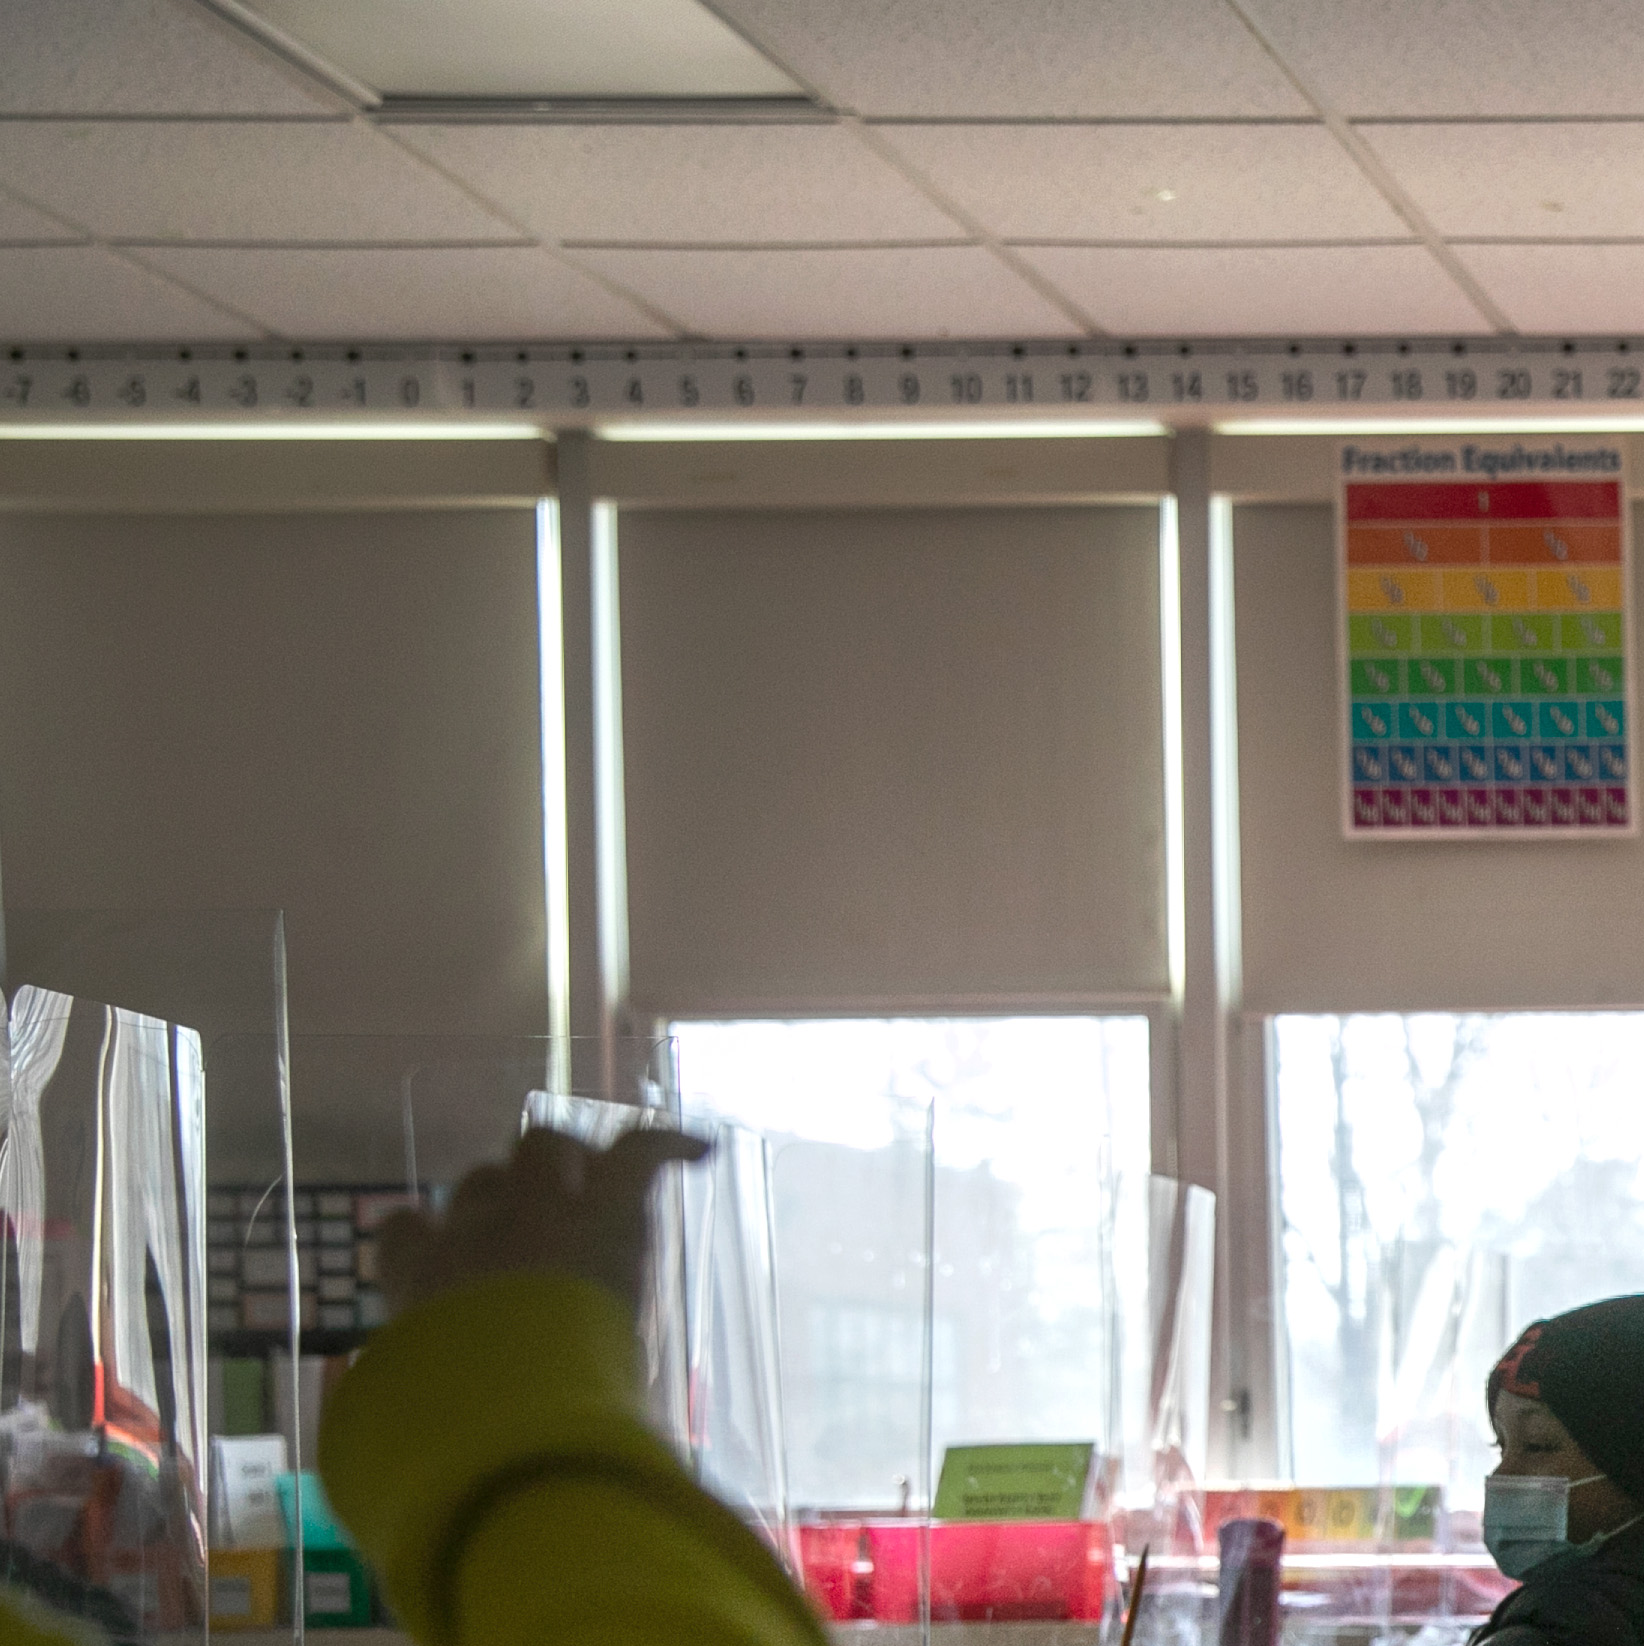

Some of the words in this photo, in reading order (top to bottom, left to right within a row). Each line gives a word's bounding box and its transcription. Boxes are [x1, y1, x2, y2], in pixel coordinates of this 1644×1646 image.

[461, 377, 477, 408] 1
[515, 377, 535, 409] 2
[569, 376, 590, 408] 3
[624, 376, 645, 408] 4
[678, 375, 700, 407] 5
[733, 376, 754, 407] 6
[788, 373, 809, 405] 7
[844, 374, 864, 406] 8
[898, 373, 920, 405] 9
[950, 373, 983, 404] 10
[1005, 373, 1034, 402] 11
[1059, 371, 1092, 403] 12
[1117, 372, 1150, 404] 13
[1172, 372, 1203, 400] 14
[1226, 370, 1258, 402] 15
[1281, 370, 1313, 401] 16
[1335, 369, 1367, 400] 17
[1390, 369, 1423, 400] 18
[1445, 369, 1477, 400] 19
[1497, 369, 1532, 399] 20
[1551, 368, 1583, 399] 21
[1607, 367, 1641, 399] 22
[1342, 446, 1455, 473] Fraction
[1461, 445, 1621, 479] Equivalents
